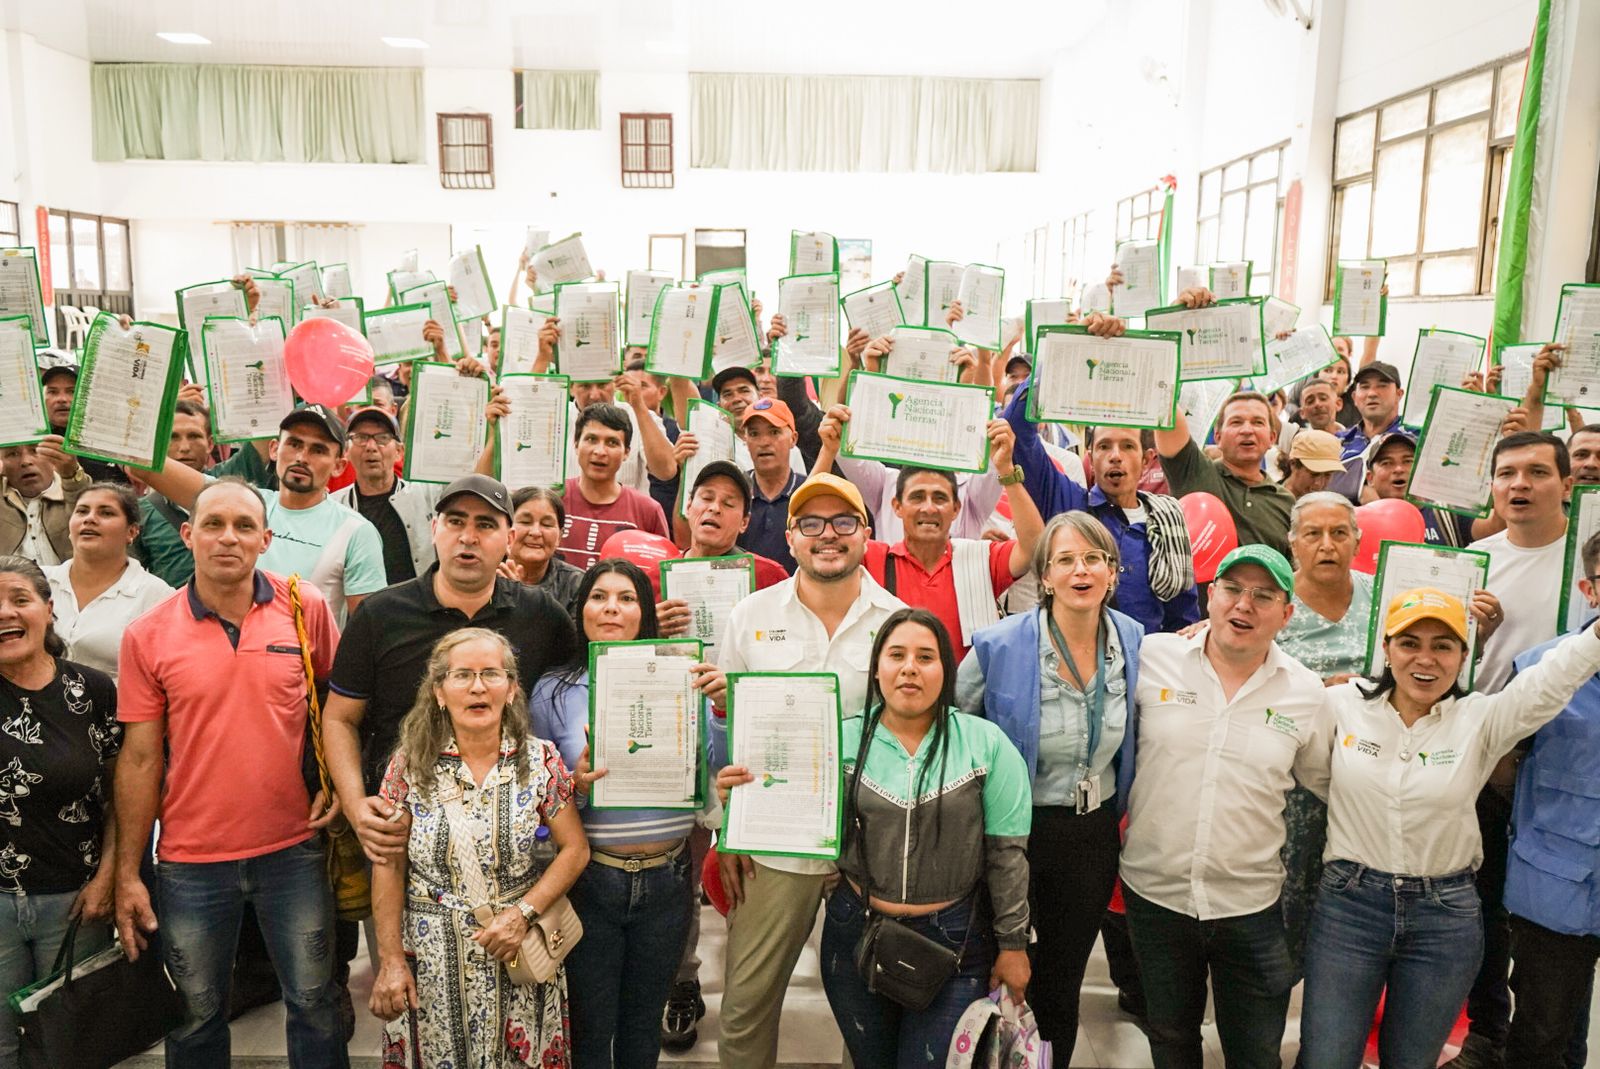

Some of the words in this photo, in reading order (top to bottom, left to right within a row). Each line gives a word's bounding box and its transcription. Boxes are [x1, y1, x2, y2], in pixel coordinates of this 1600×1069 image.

[132, 359, 140, 378] VIDA
[1100, 360, 1128, 368] Agencia
[1099, 368, 1130, 376] Nacional
[905, 395, 943, 407] Agencia
[905, 404, 945, 416] Nacional
[904, 413, 937, 424] Tierras
[1424, 528, 1439, 540] IA
[699, 606, 708, 637] Nacional
[628, 705, 637, 738] Agencia
[636, 701, 644, 738] Nacional
[780, 742, 788, 771] Tierras
[1358, 746, 1378, 757] VIDA
[951, 778, 964, 788] LOVE
[880, 789, 895, 800] LOVE
